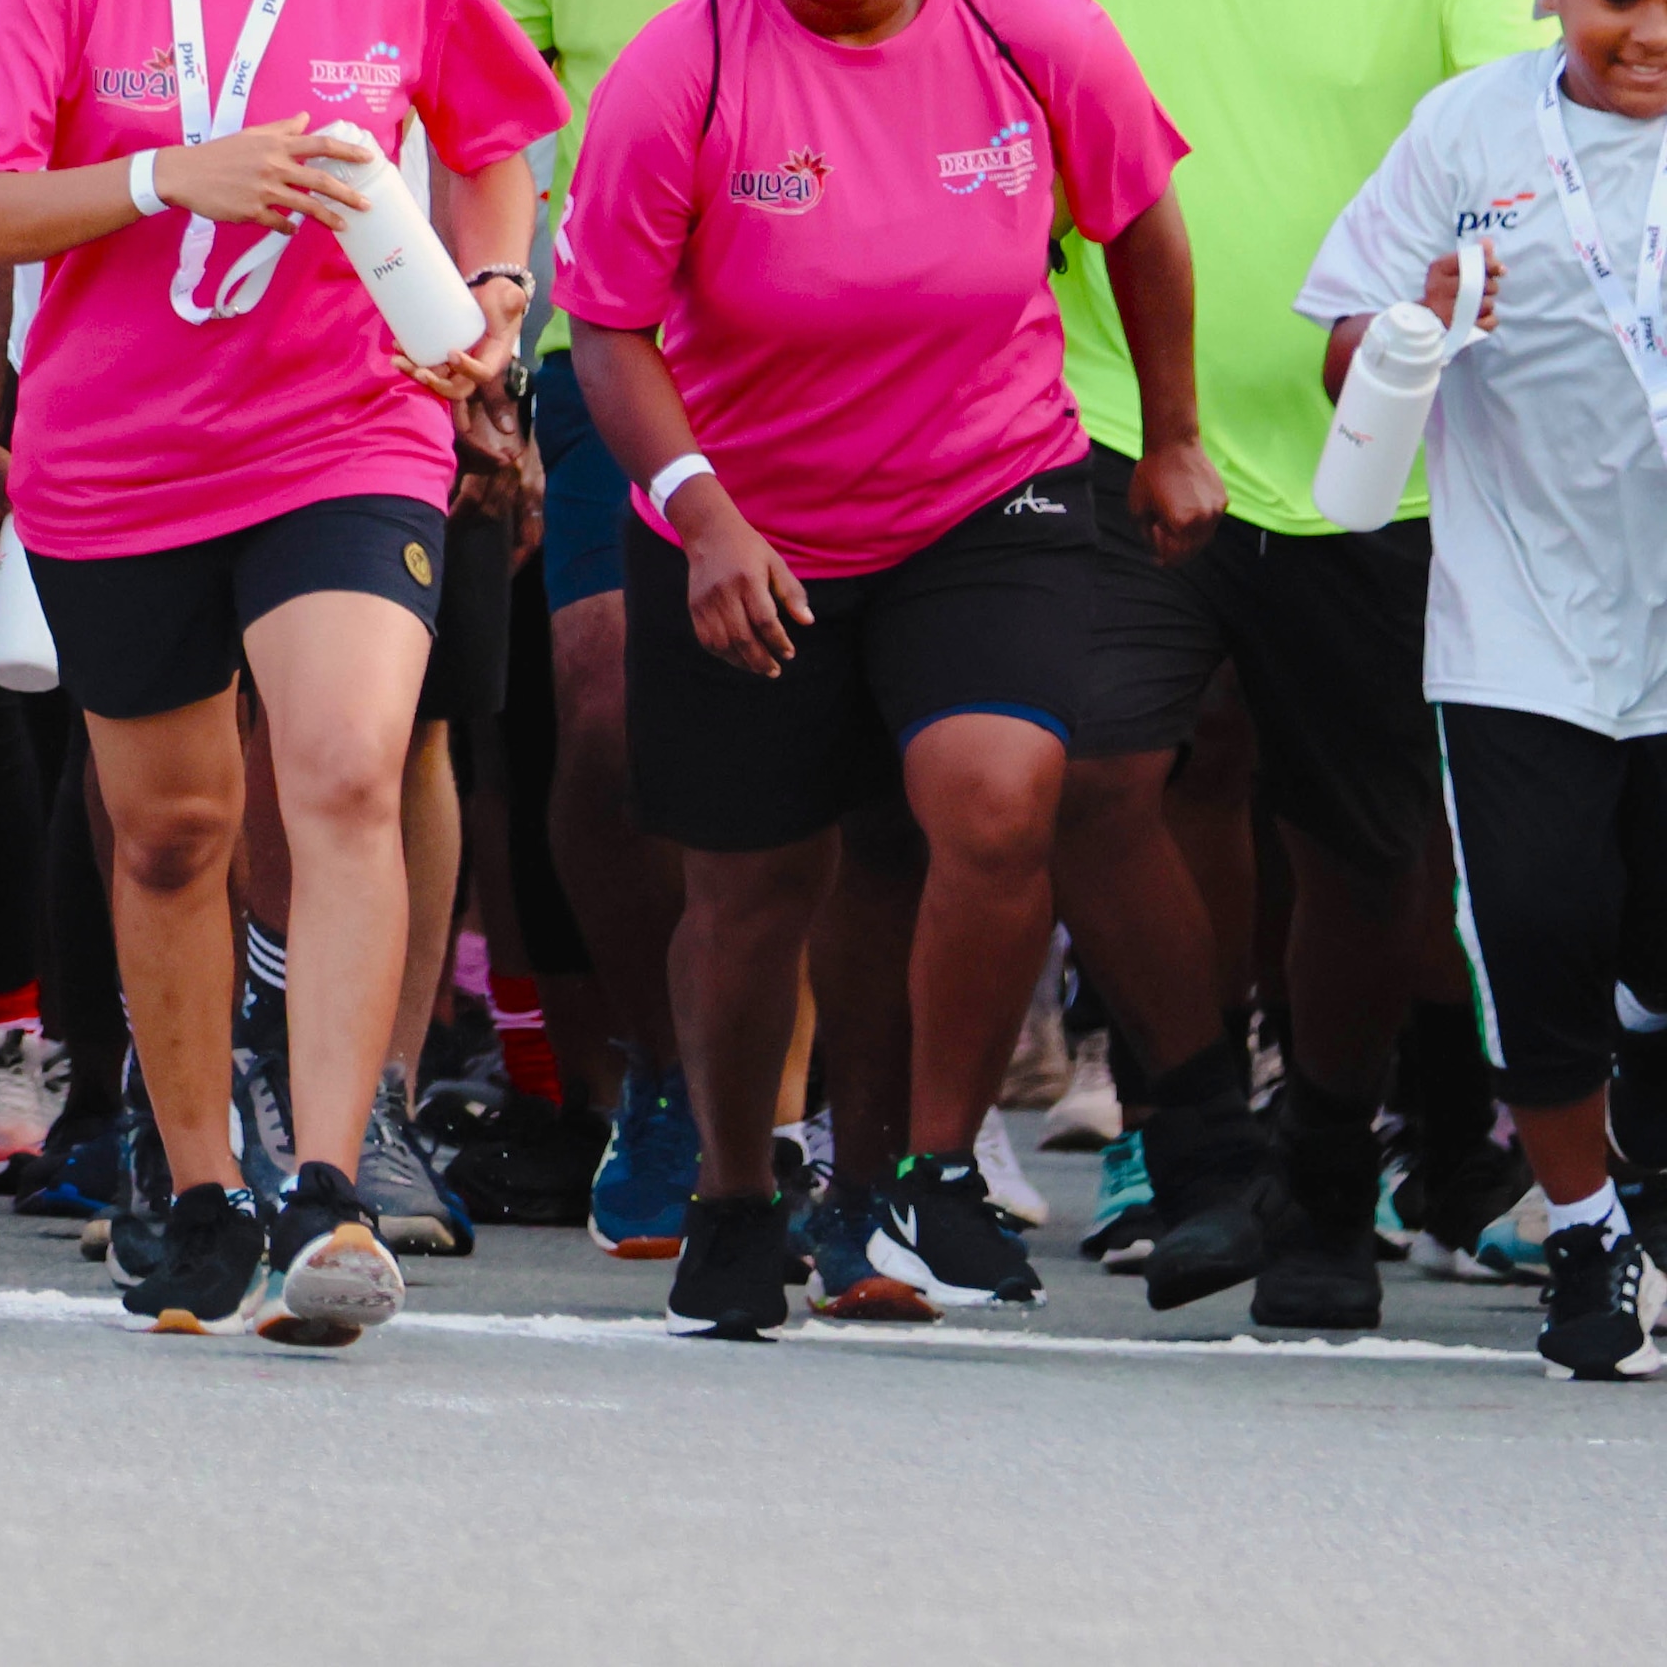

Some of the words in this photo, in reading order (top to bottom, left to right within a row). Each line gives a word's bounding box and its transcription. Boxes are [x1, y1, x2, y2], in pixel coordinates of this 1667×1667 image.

[178, 42, 196, 79] pwc
[232, 60, 252, 98] pwc
[1457, 210, 1518, 237] pwc
[373, 256, 405, 281] pwc
